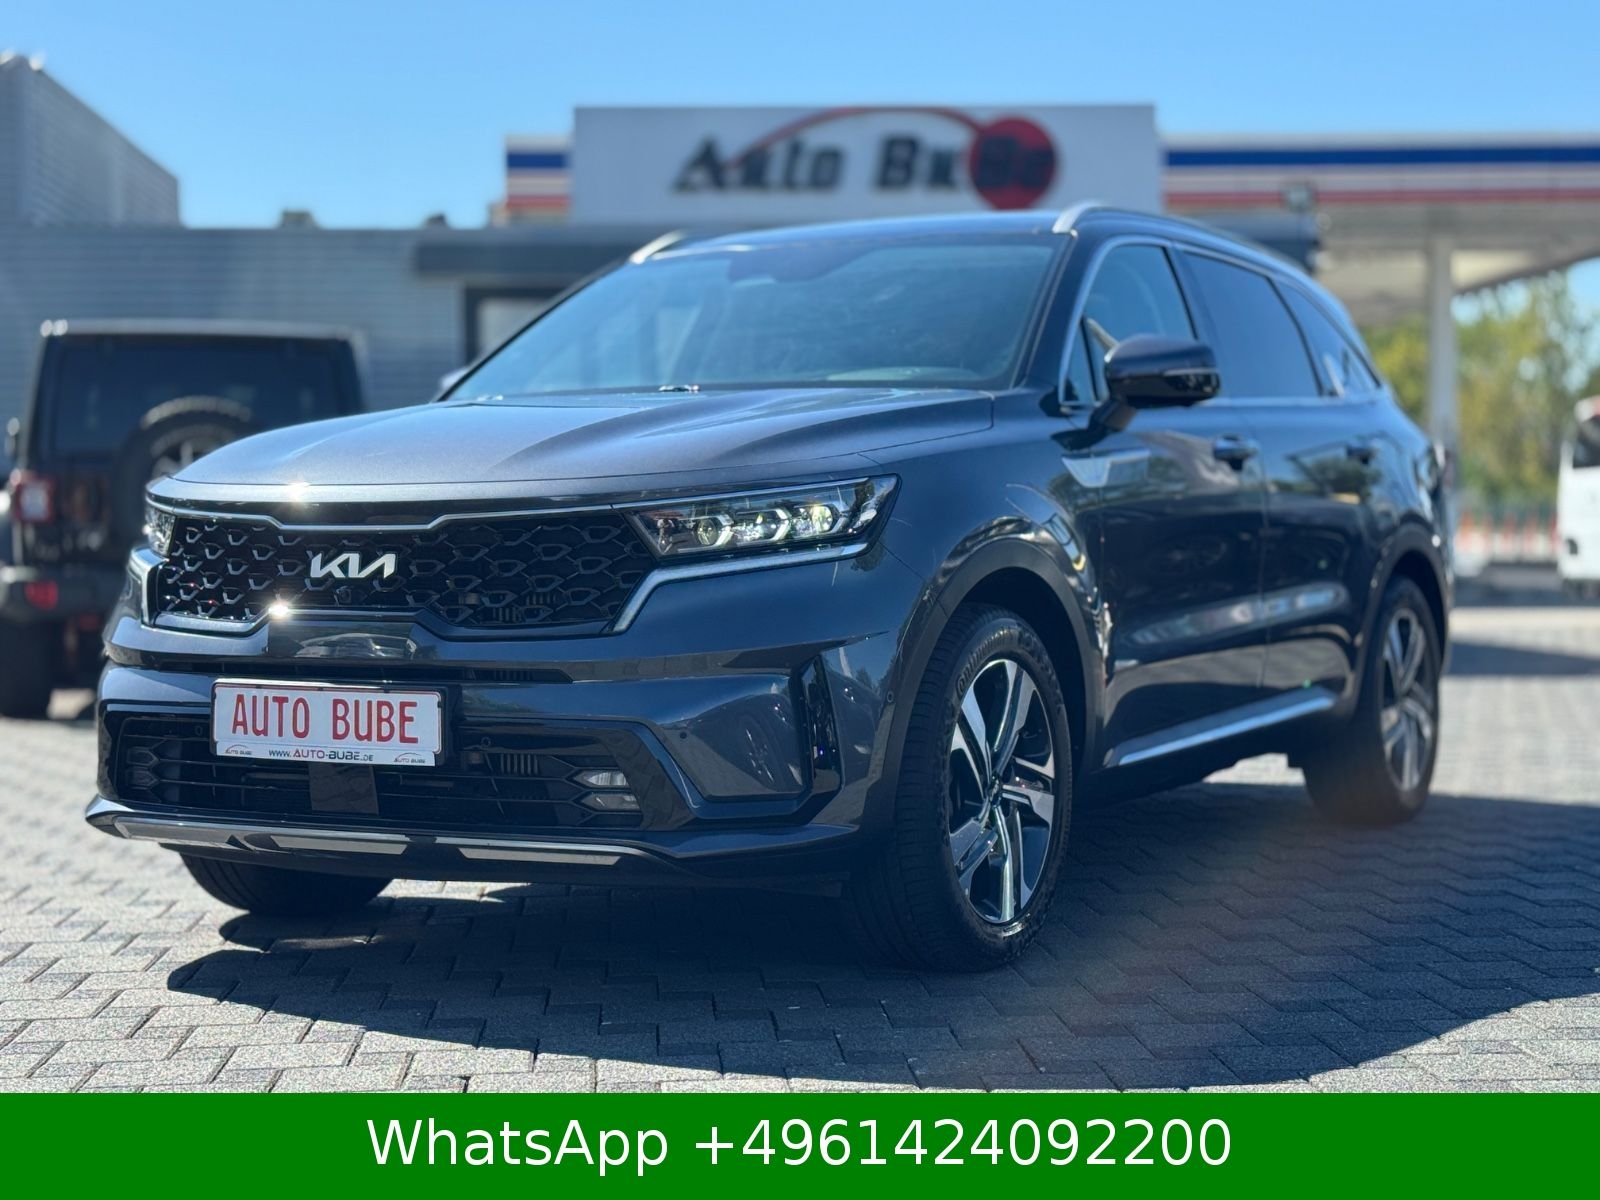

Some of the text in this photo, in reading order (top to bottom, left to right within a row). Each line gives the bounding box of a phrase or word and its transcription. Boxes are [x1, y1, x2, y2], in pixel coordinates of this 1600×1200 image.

[671, 133, 846, 191] Auto
[309, 552, 396, 578] KIA
[231, 693, 419, 744] AUTO BUBE
